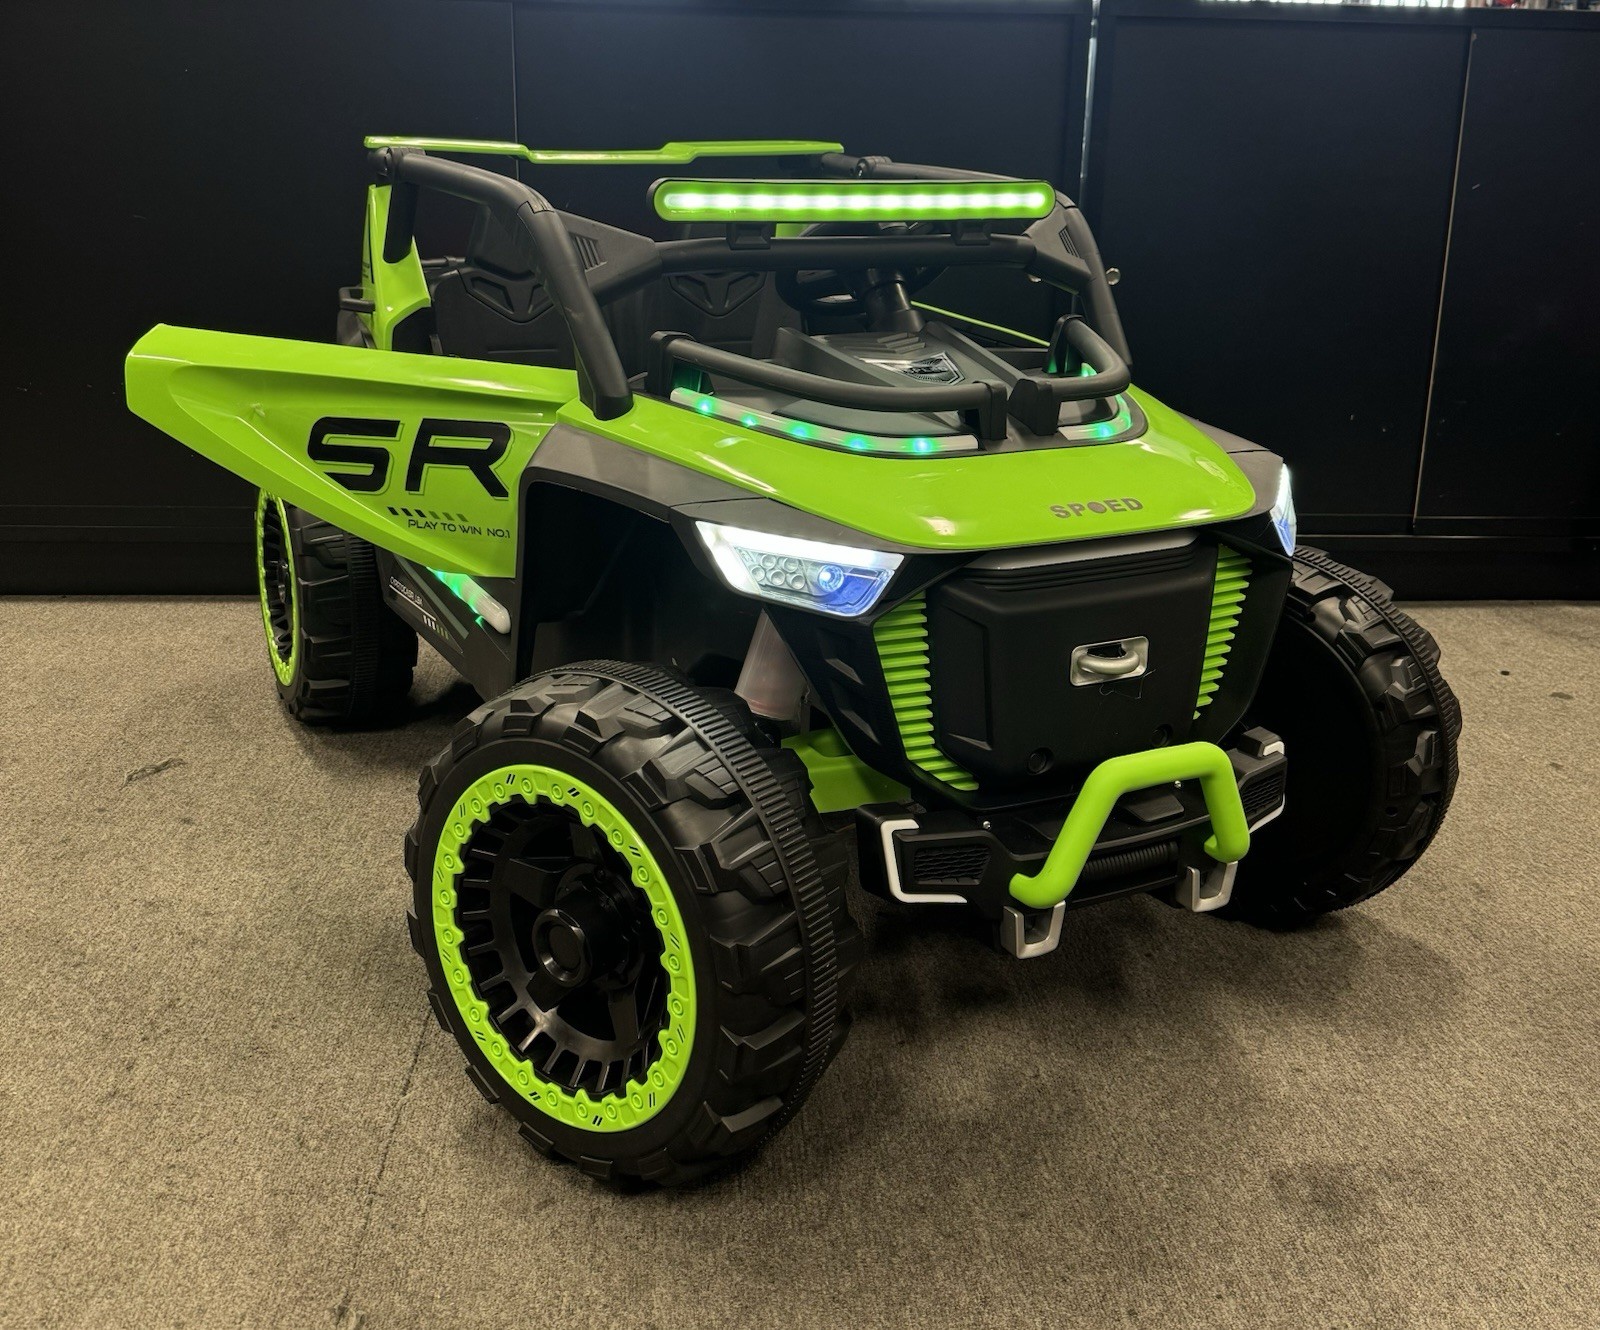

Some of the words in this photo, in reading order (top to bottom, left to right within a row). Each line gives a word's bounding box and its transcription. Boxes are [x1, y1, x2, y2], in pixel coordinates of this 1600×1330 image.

[307, 416, 513, 499] SR
[408, 519, 437, 531] PLAY
[440, 522, 457, 533] TO
[459, 524, 482, 536] WIN
[487, 528, 511, 539] NO.1
